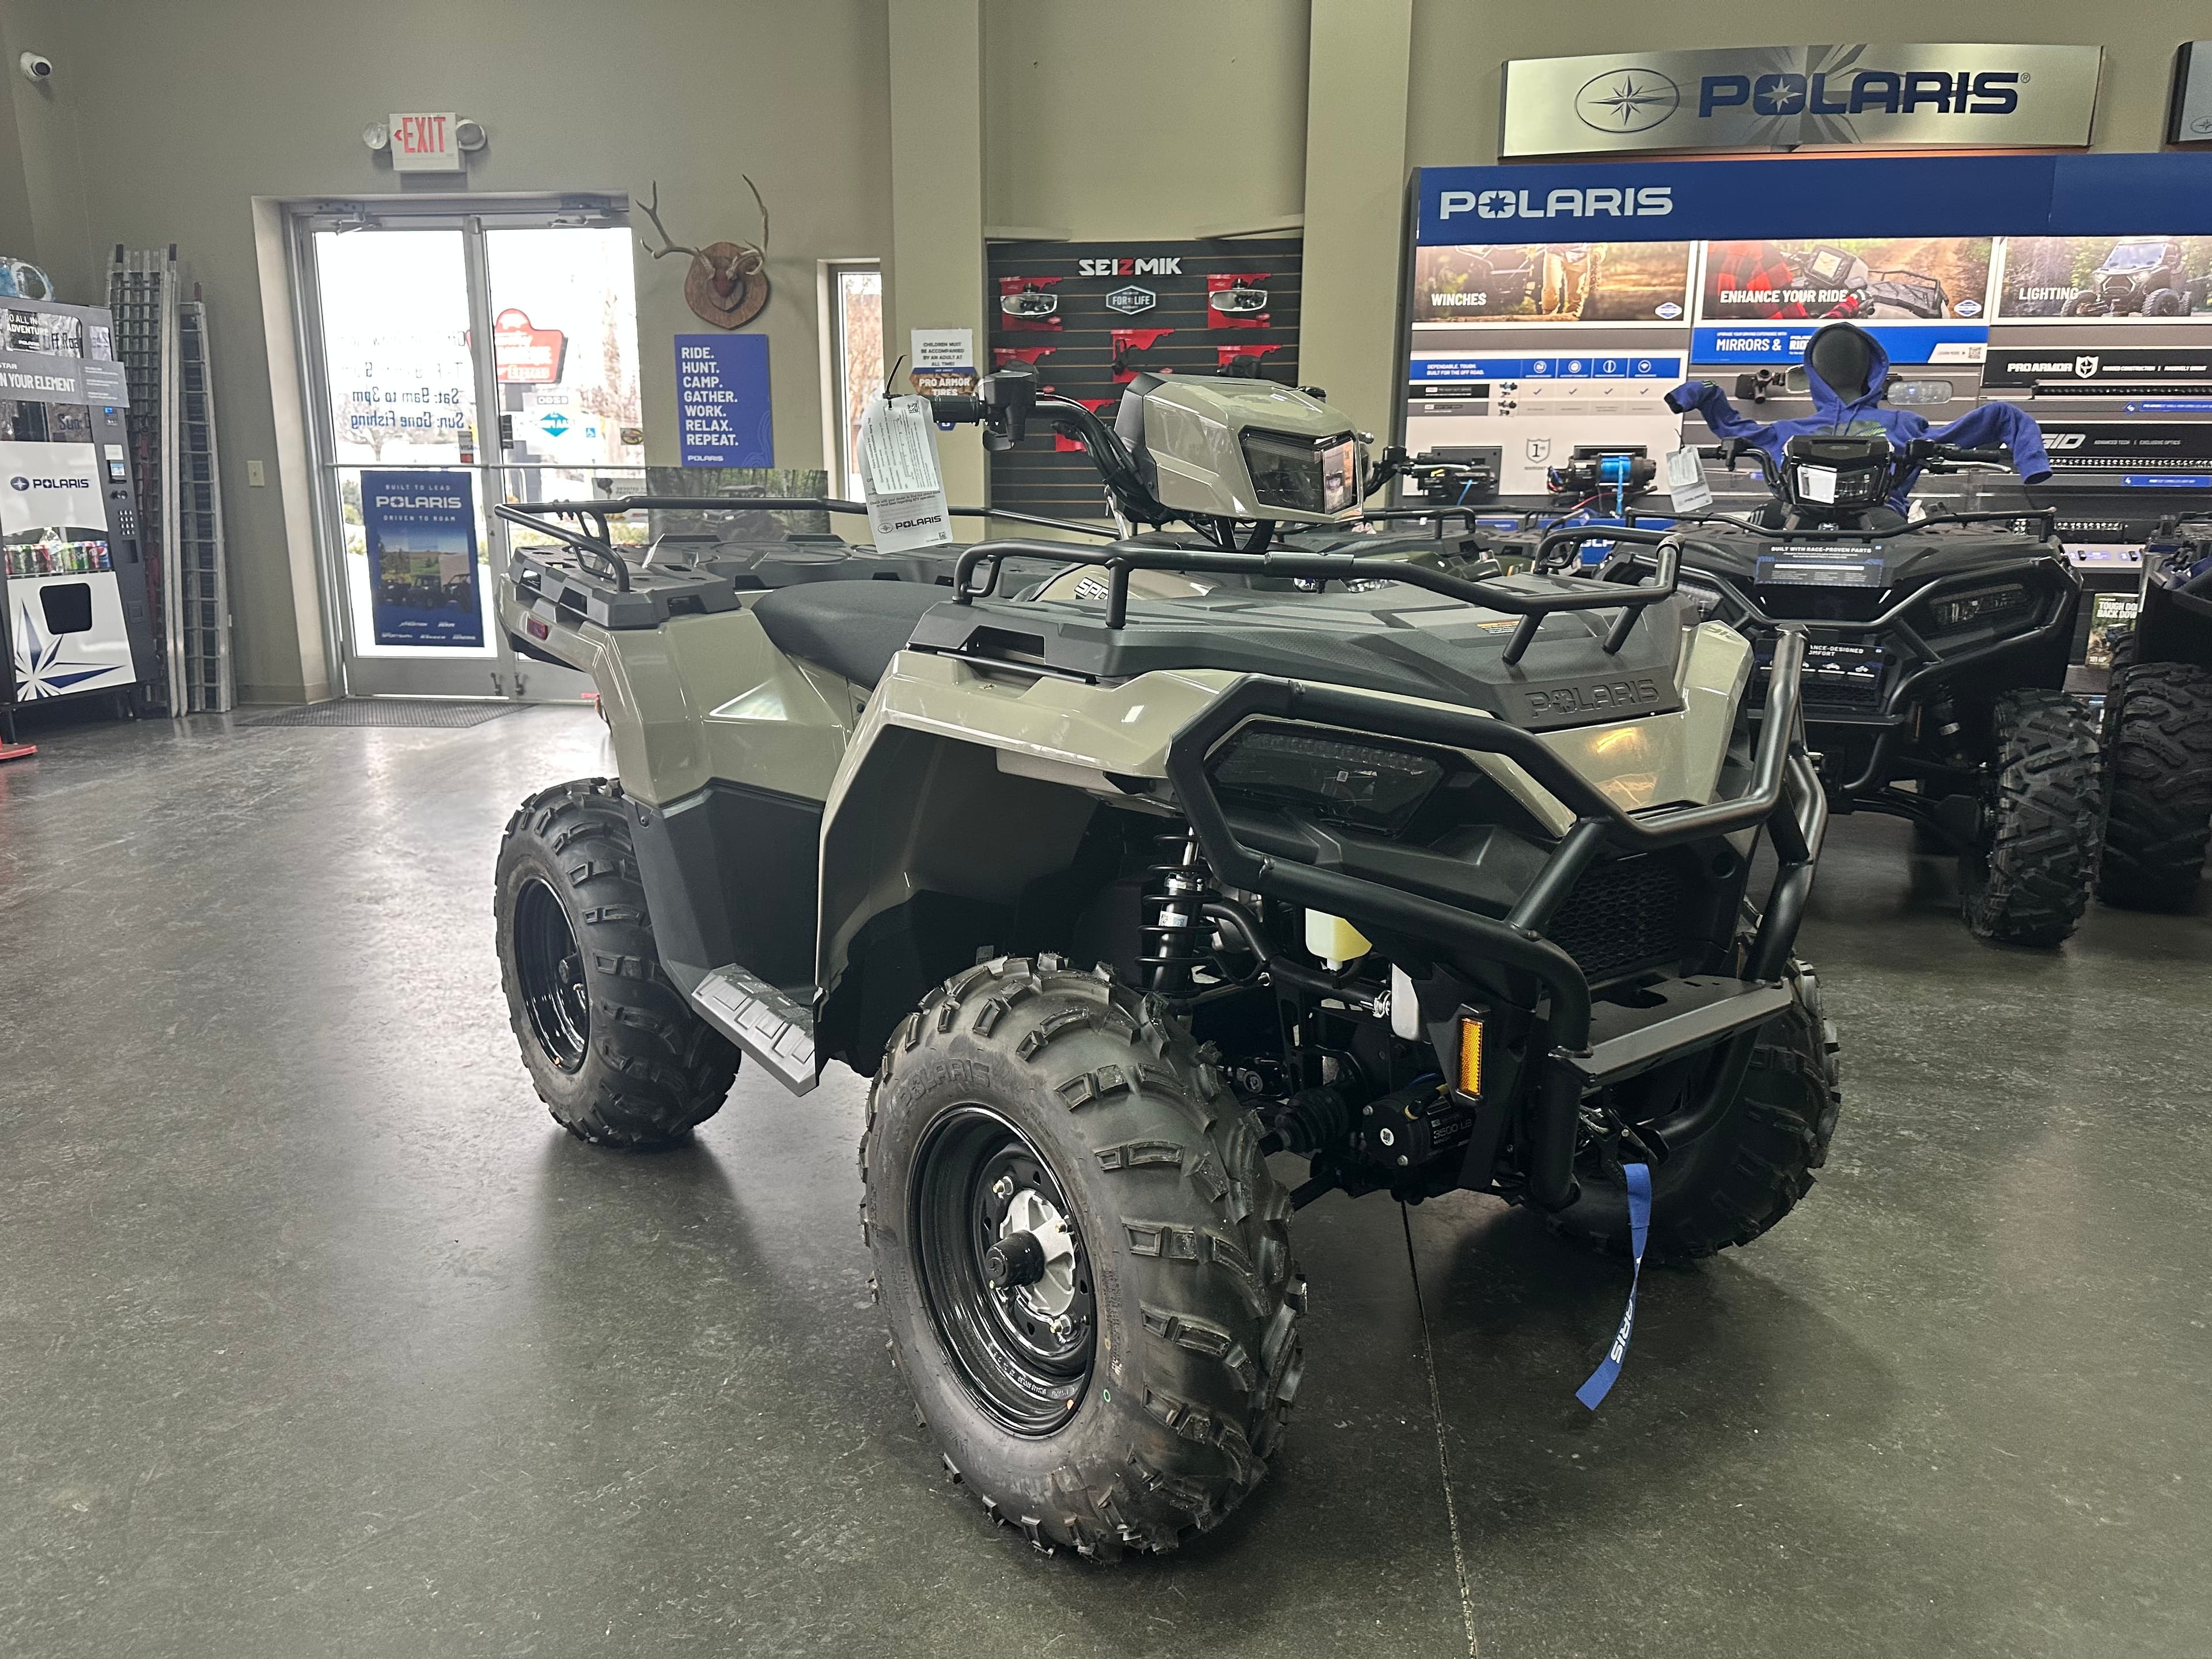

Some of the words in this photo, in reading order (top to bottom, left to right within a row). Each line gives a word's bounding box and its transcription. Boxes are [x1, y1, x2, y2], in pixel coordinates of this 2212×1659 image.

[1698, 71, 2019, 118] POLARIS
[403, 117, 446, 153] EXIT
[1440, 187, 1673, 219] POLARIS
[1078, 257, 1183, 276] SEIZMIK
[1431, 292, 1487, 306] WINCHES
[1720, 290, 1781, 303] ENHANCE
[1782, 290, 1817, 303] YOUR
[1818, 289, 1848, 302] RIDE
[2019, 287, 2079, 300] LIGHTING
[1112, 296, 1127, 305] FOR
[1134, 296, 1150, 305] LIFE
[16, 315, 29, 324] ALL
[1716, 338, 1770, 351] MIRRORS
[1772, 338, 1782, 351] &
[681, 347, 714, 359] RIDE.
[682, 362, 719, 373] HUNT.
[8, 373, 34, 389] YOUR
[35, 375, 75, 392] ELEMENT
[683, 376, 723, 388] CAMP.
[919, 378, 937, 387] PRO
[939, 378, 970, 387] ARMOR
[684, 391, 738, 403] GATHER.
[685, 405, 726, 416] WORK.
[685, 420, 733, 431] RELAX.
[687, 434, 738, 446] REPEAT.
[2040, 433, 2086, 449] GID
[1532, 444, 1540, 457] 1
[33, 479, 89, 488] POLARIS
[376, 496, 462, 509] POLARIS
[895, 516, 941, 529] POLARIS
[2099, 602, 2125, 611] TOUGH
[2125, 603, 2138, 611] DO
[2097, 609, 2119, 618] BACK
[2119, 611, 2138, 619] DOW
[1525, 679, 1659, 718] POLARIS
[892, 1057, 991, 1115] POLARIS
[1433, 1124, 1458, 1138] 3500
[1460, 1119, 1472, 1130] LB
